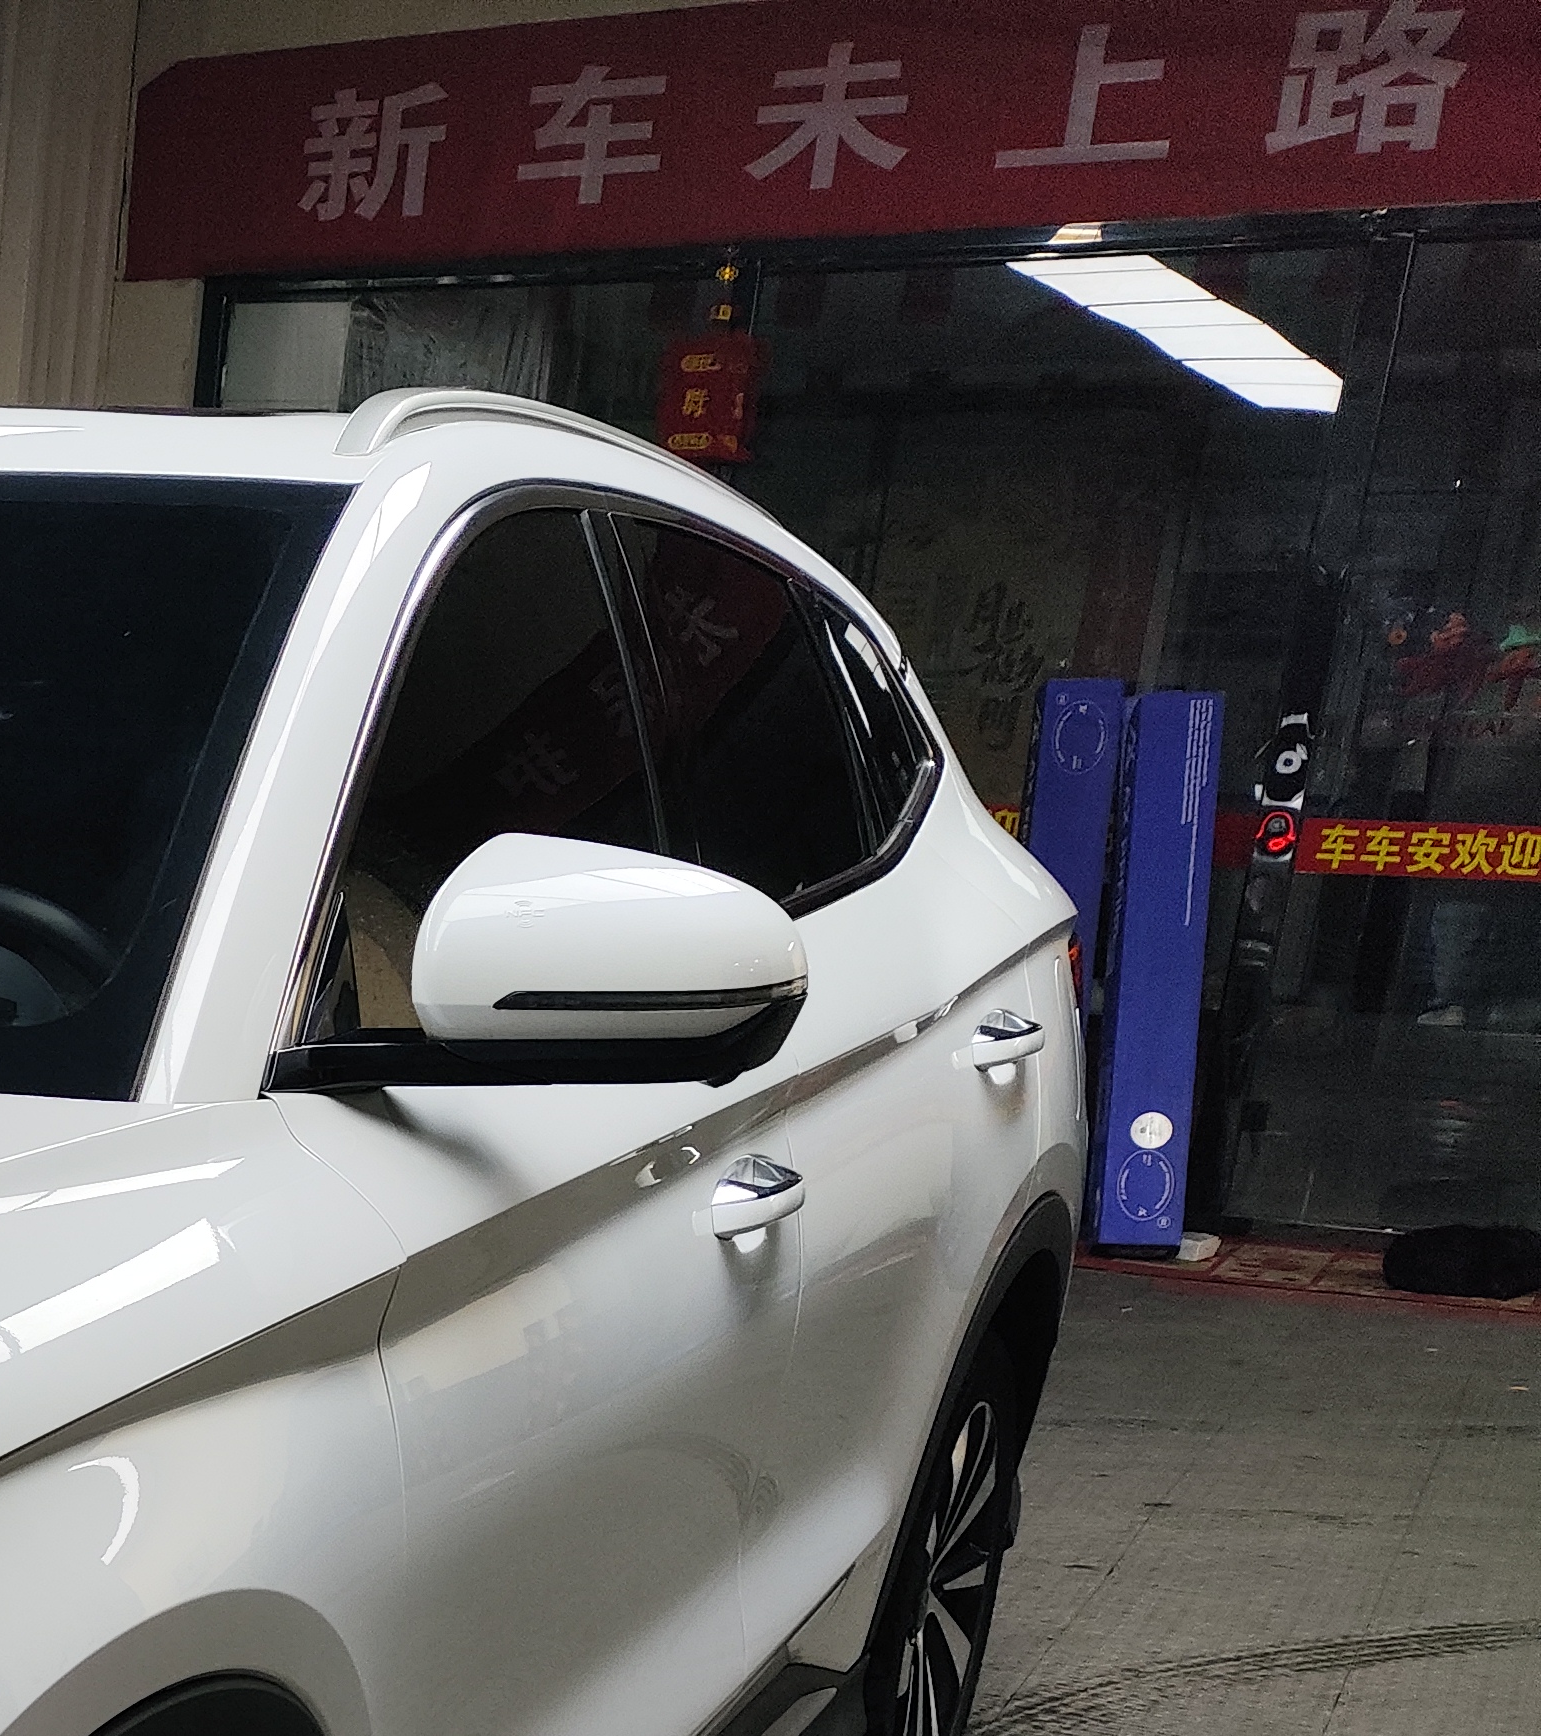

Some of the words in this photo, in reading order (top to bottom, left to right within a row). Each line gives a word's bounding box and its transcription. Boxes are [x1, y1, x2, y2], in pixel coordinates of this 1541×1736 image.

[297, 0, 1469, 221] 新车未上路
[1315, 823, 1541, 877] 车车安欢迎
